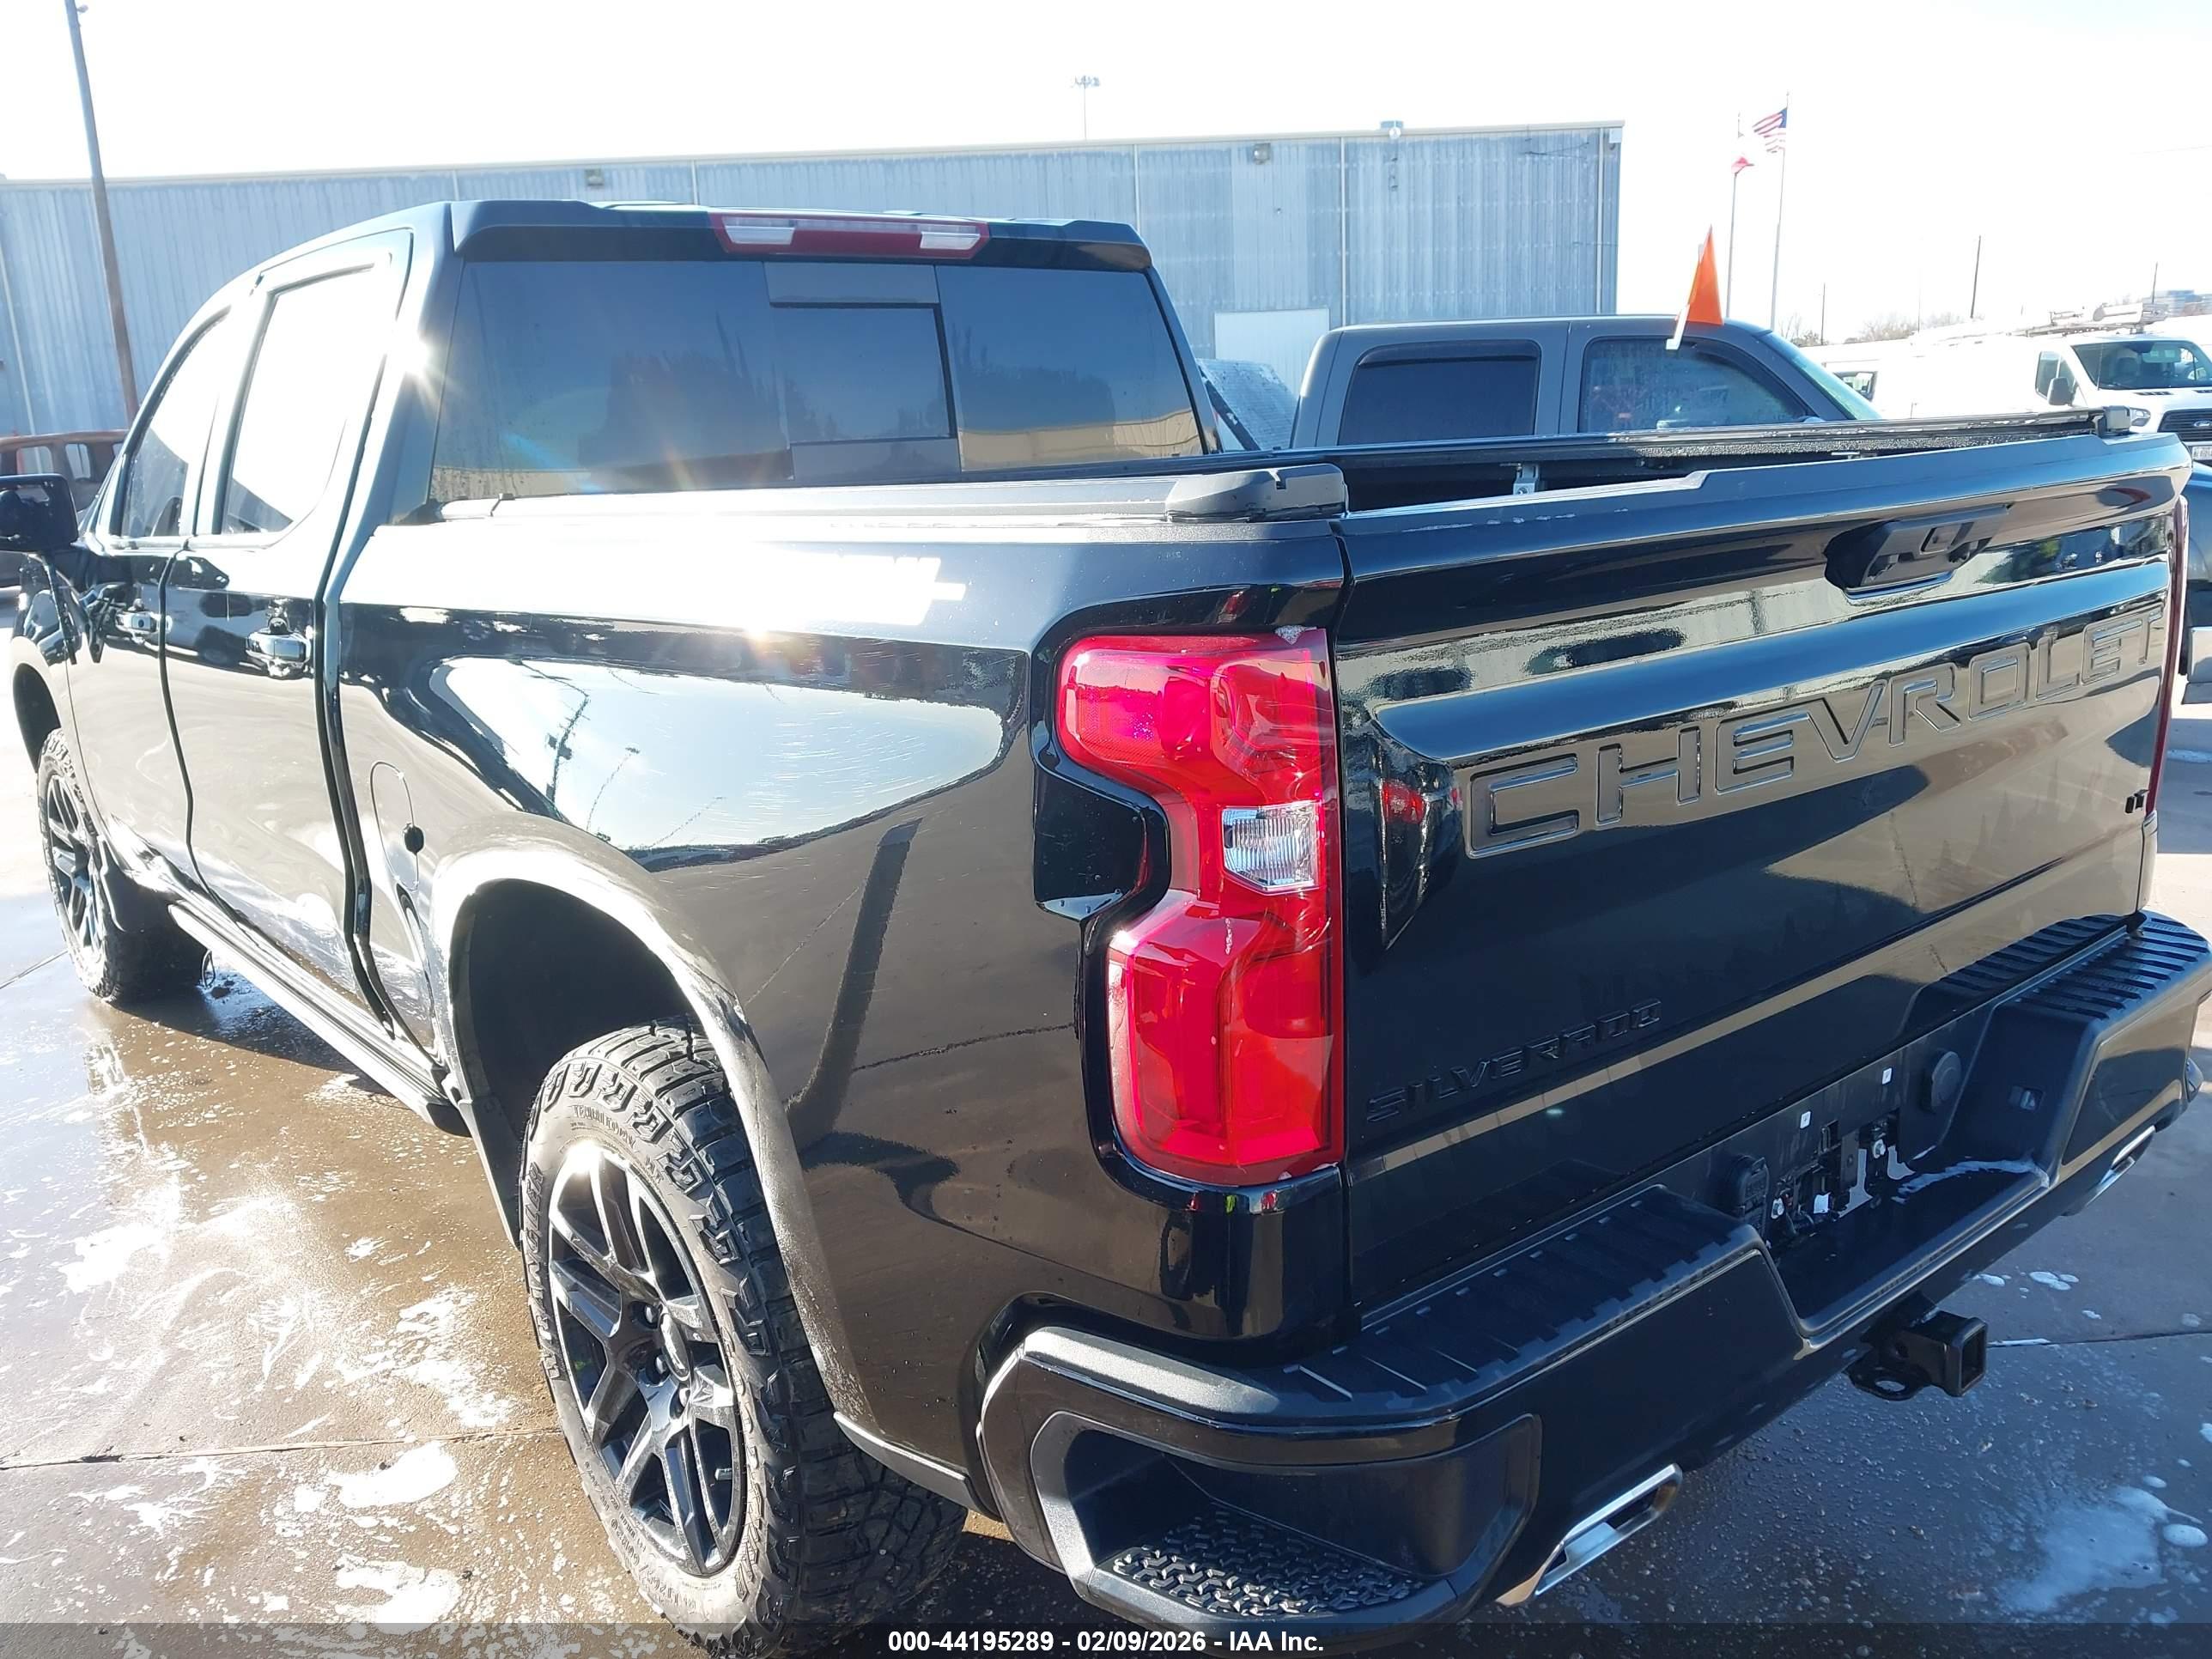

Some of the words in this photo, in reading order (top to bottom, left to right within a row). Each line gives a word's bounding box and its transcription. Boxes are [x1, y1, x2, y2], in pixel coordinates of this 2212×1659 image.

[1466, 605, 2164, 859] CHEVROLET
[1366, 997, 1662, 1121] SILVERADO
[524, 1161, 561, 1380] WRANGLER
